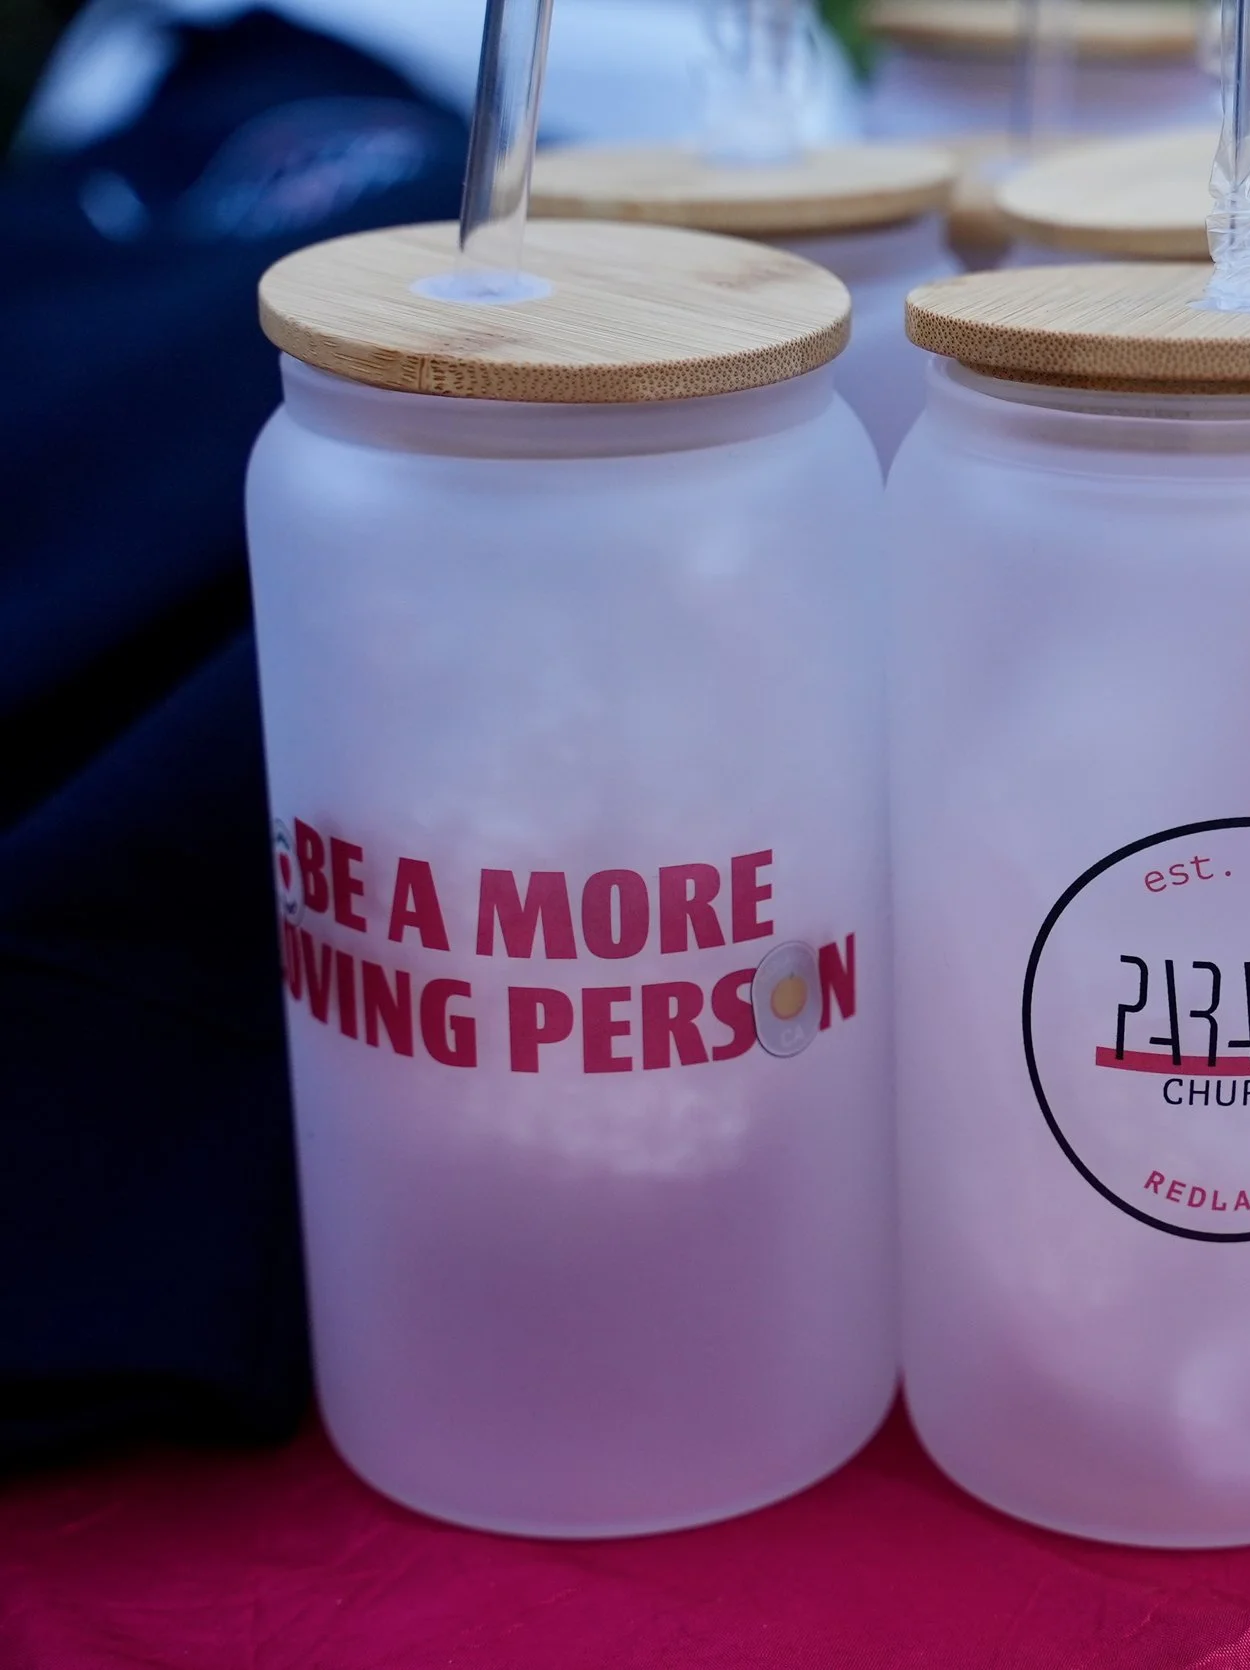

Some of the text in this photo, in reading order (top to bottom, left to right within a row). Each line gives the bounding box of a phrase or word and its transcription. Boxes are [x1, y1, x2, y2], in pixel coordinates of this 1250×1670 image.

[294, 815, 775, 961] BE A MORE
[1143, 854, 1232, 893] est.
[282, 915, 856, 1075] OVING PERSN
